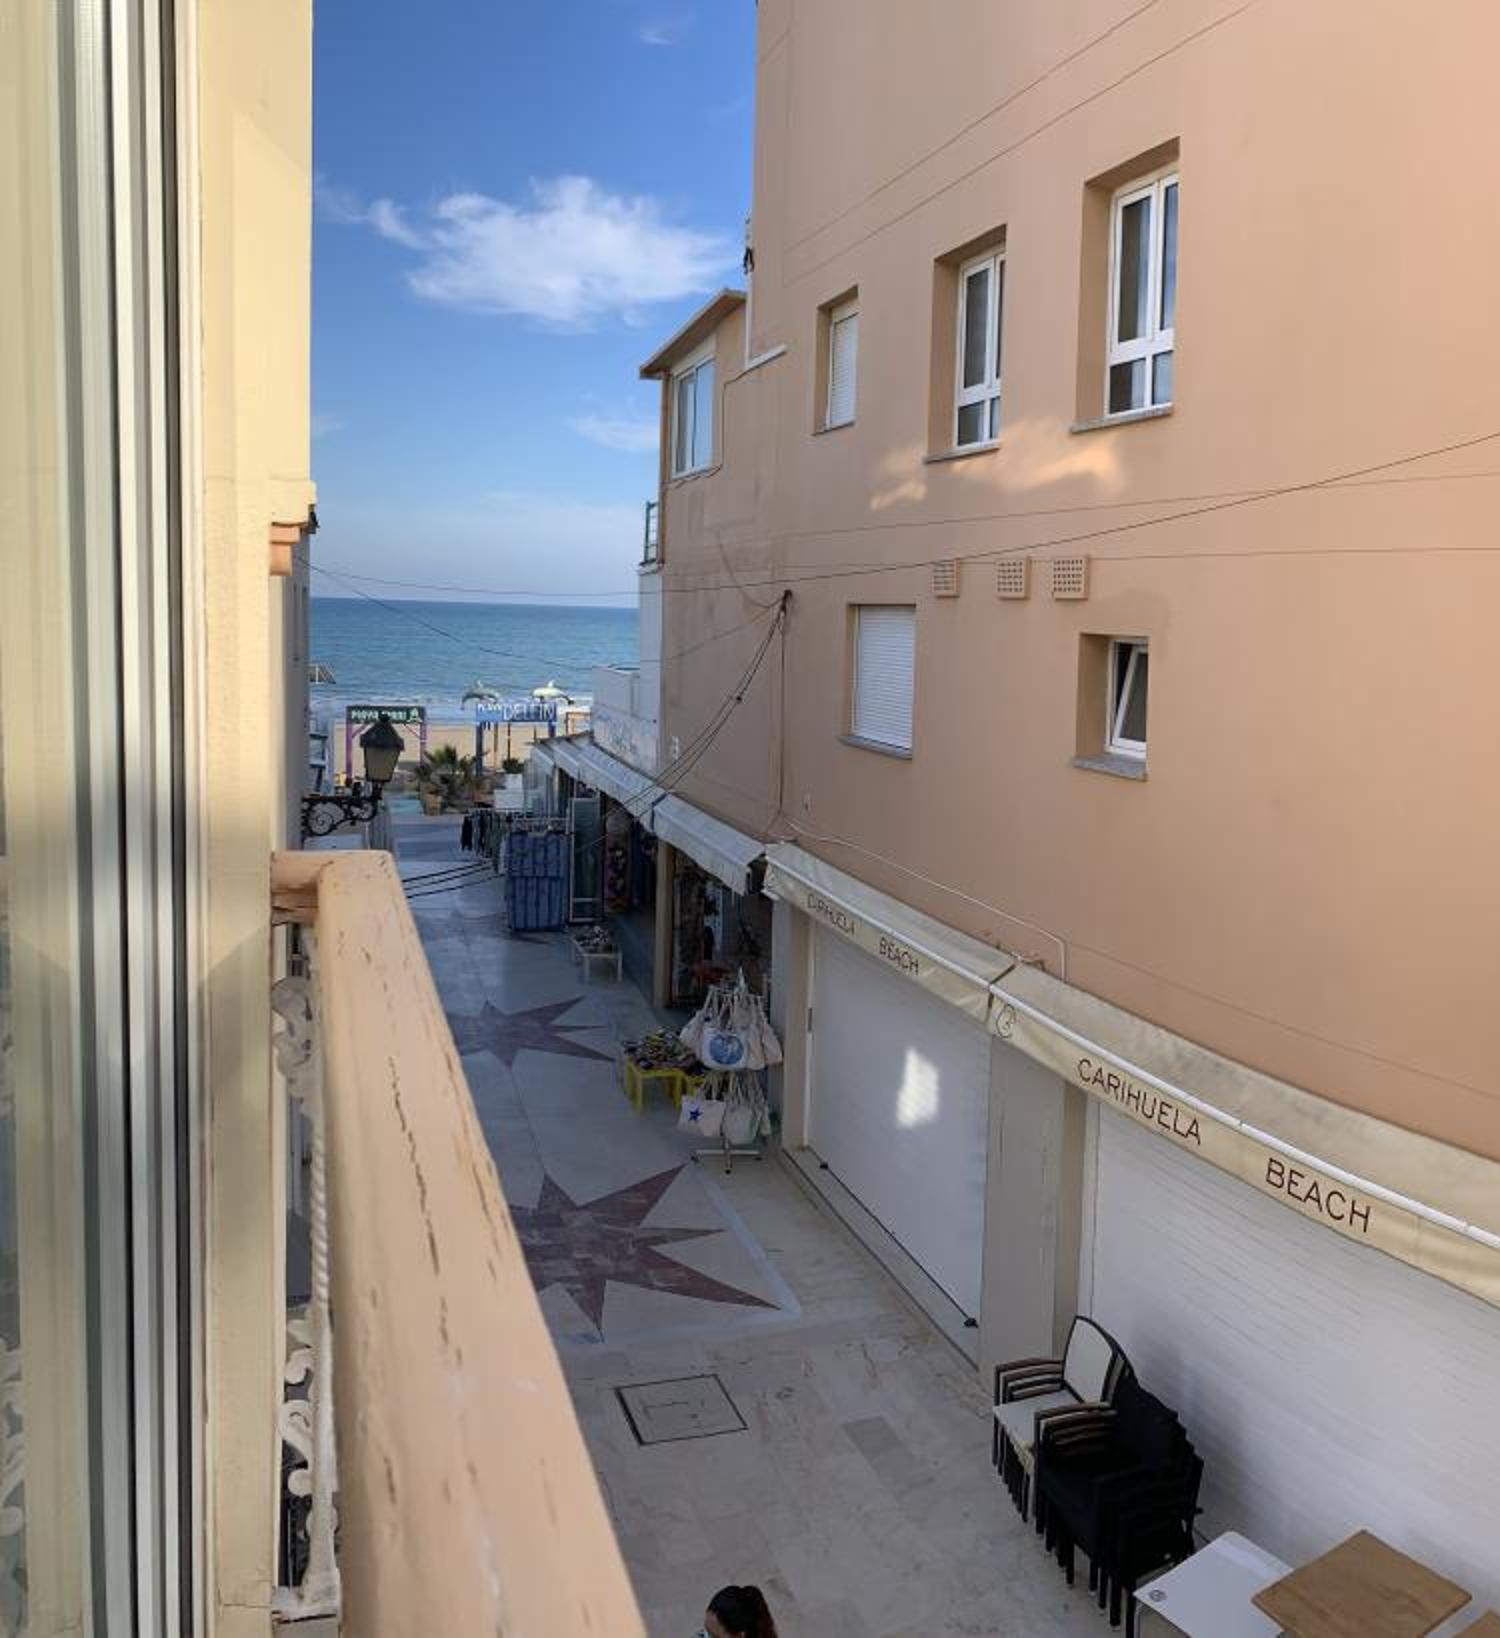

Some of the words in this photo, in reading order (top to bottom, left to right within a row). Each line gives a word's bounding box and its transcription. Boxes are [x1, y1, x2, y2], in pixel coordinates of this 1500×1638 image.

[879, 936, 919, 976] BEACH
[1077, 1058, 1201, 1147] CARIHUELA
[1265, 1157, 1371, 1233] BEACH
